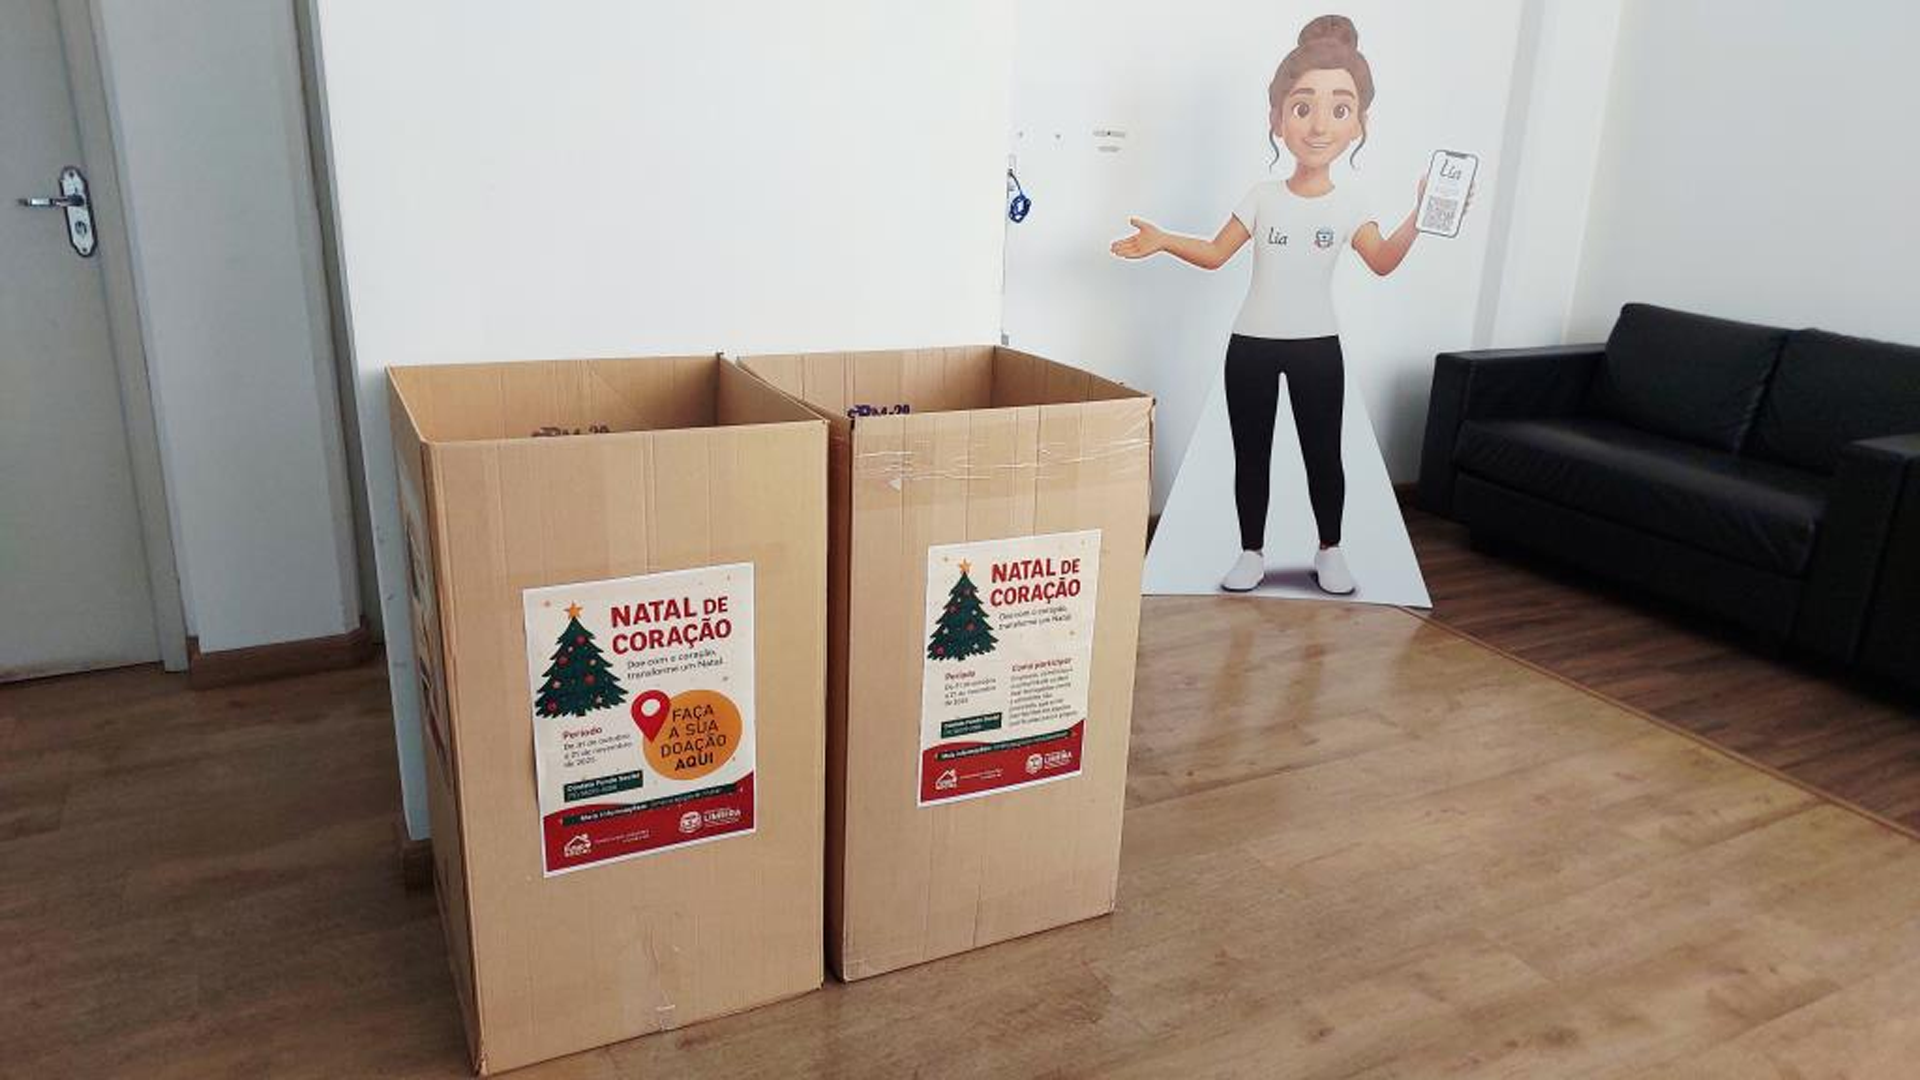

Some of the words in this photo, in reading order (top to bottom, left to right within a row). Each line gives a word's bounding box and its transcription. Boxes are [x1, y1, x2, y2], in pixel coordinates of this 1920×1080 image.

[1440, 159, 1461, 180] Lia
[1268, 226, 1288, 245] Lia
[991, 558, 1056, 584] NATAL
[1061, 558, 1081, 575] DE
[990, 577, 1081, 607] CORAÇÃO
[611, 597, 698, 629] NATAL
[703, 596, 729, 615] DE
[612, 617, 732, 655] CORAÇÃO
[627, 666, 679, 679] transforme
[680, 662, 696, 671] um
[647, 656, 669, 666] com
[672, 704, 714, 722] FAÇA
[669, 726, 680, 739] A
[686, 720, 719, 736] SUA
[660, 733, 727, 758] DOAÇÃO
[675, 752, 714, 771] AQUI
